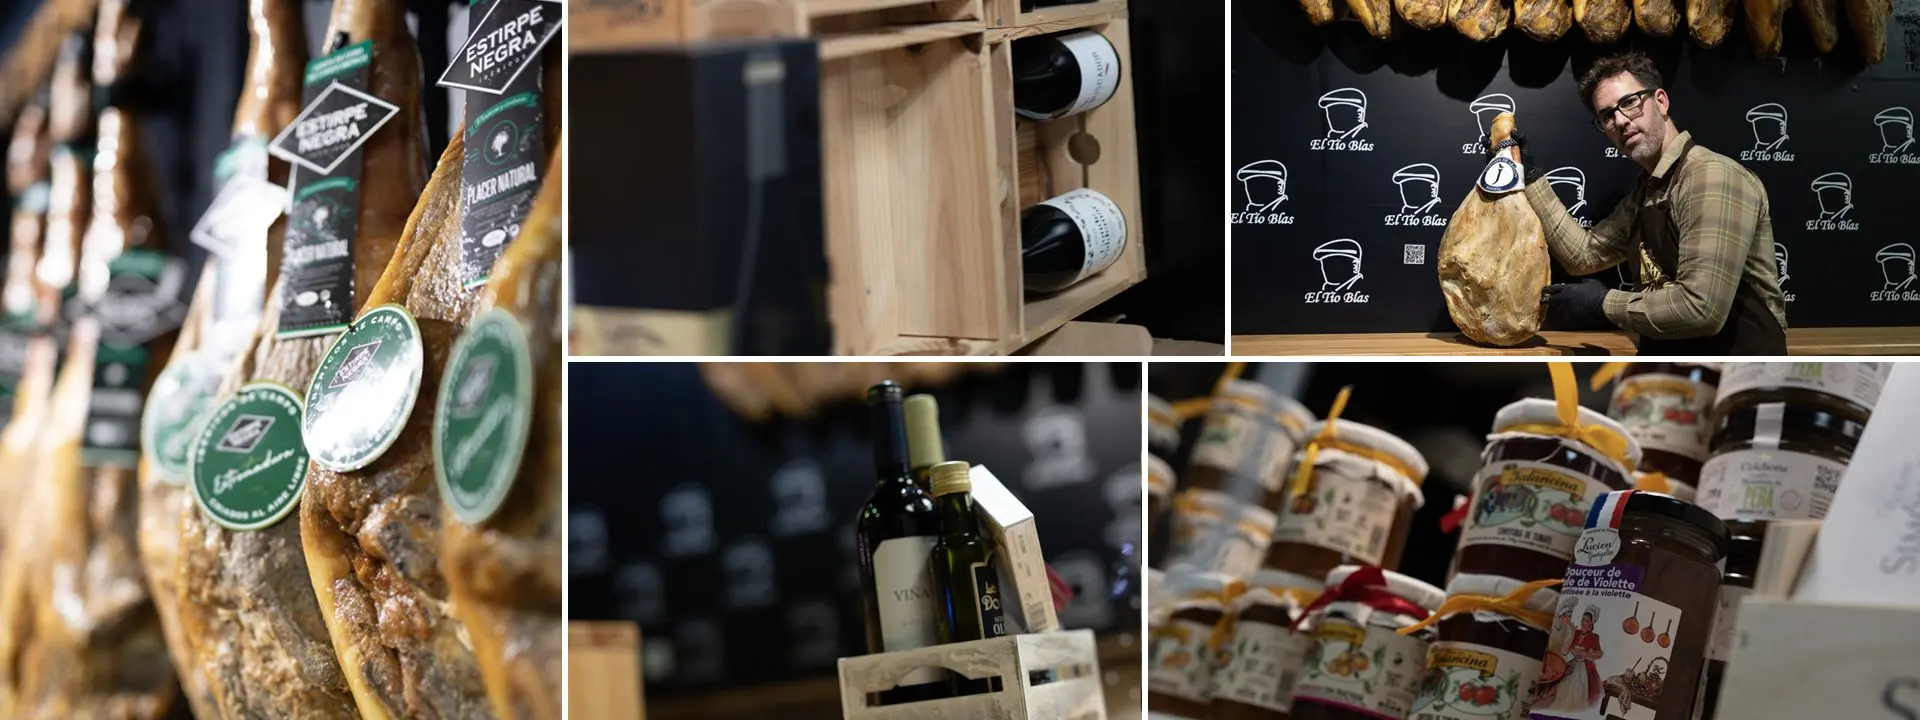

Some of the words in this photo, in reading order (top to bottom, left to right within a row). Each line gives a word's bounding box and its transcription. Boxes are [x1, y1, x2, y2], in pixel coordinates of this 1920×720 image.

[466, 5, 544, 63] ESTIRPE
[470, 30, 537, 78] NEGRA
[295, 102, 368, 138] ESTIRPE
[298, 122, 360, 154] NEGRA
[1310, 139, 1328, 150] El
[1348, 139, 1375, 152] Blas
[1462, 142, 1480, 154] El
[1740, 150, 1755, 161] El
[1773, 150, 1795, 162] Blas
[1869, 152, 1883, 164] El
[1231, 212, 1247, 224] El
[1267, 212, 1295, 225] Blas
[1384, 213, 1402, 226] El
[1422, 214, 1447, 227] Blas
[1806, 219, 1821, 231] El
[1837, 219, 1860, 231] Blas
[1304, 291, 1322, 303] El
[1343, 291, 1370, 304] Blas
[1782, 290, 1796, 302] las
[1870, 290, 1885, 301] El
[370, 315, 403, 332] CAMPO
[251, 509, 266, 518] AL
[267, 491, 290, 511] AIRE
[288, 456, 306, 490] LIBRE
[1577, 536, 1613, 554] Lucien
[1607, 567, 1621, 577] de
[1577, 577, 1590, 587] de
[1593, 577, 1636, 590] Violette
[1601, 590, 1632, 599] violette
